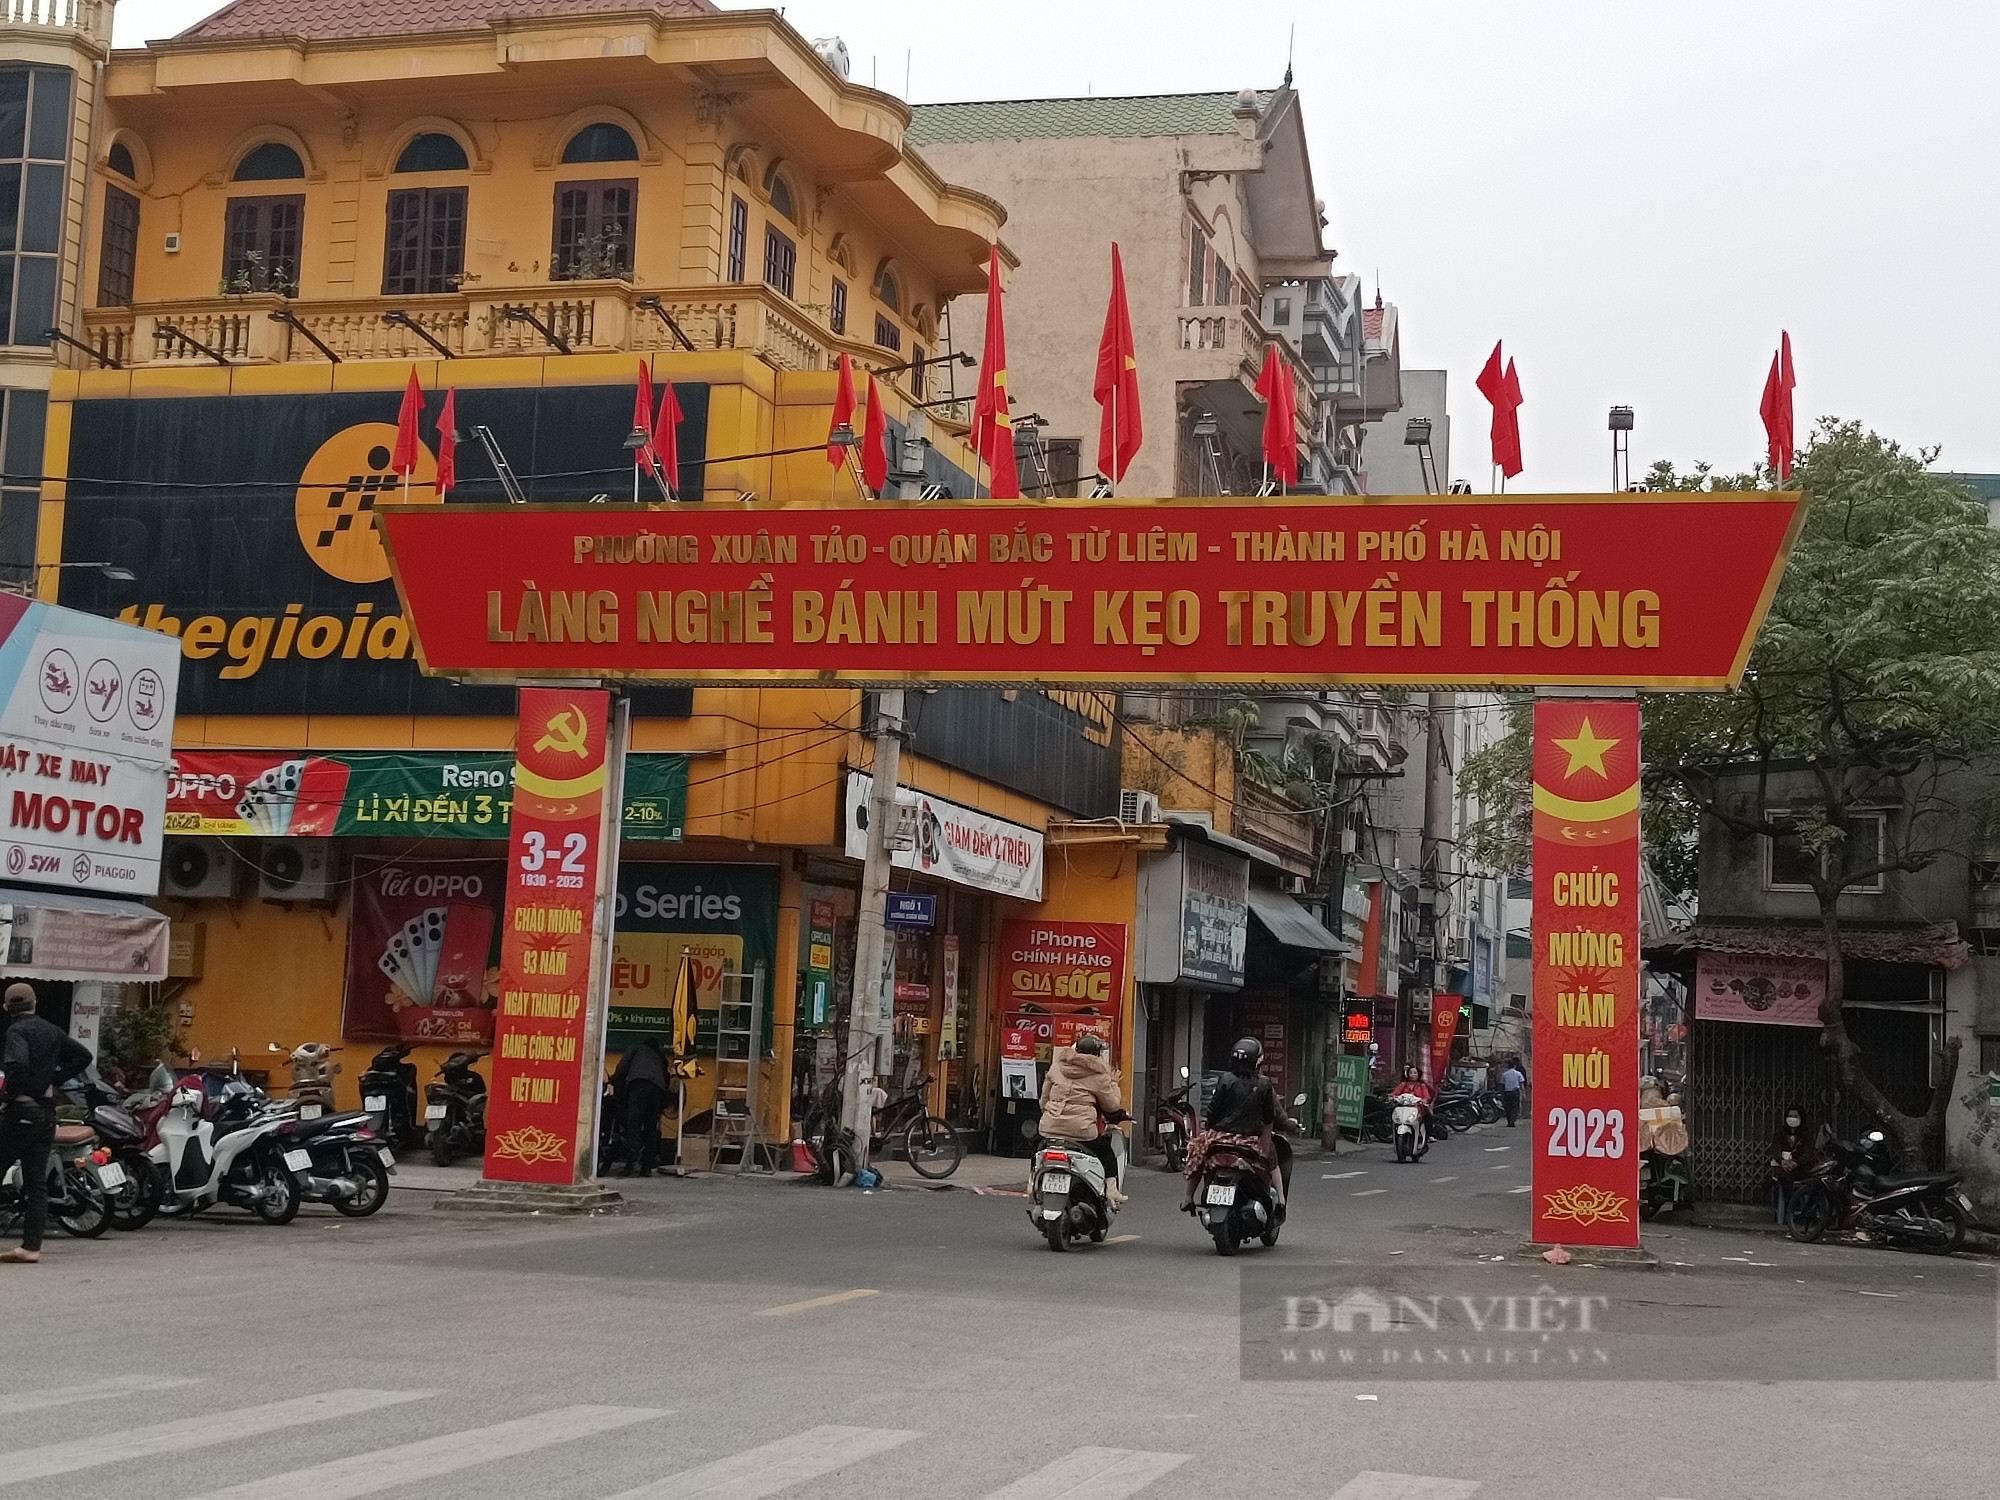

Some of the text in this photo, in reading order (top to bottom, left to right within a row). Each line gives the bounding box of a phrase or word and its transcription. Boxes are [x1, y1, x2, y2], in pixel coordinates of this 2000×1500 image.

[574, 529, 698, 564] PHƯỜNG
[711, 528, 796, 563] XUÂN
[990, 521, 1052, 563] BẮC
[1067, 526, 1111, 562] TỪ
[1119, 526, 1197, 562] LIÊM
[1232, 525, 1344, 562] THÀNH
[1358, 520, 1428, 562] PHỐ
[1440, 524, 1490, 561] HÀ
[1501, 524, 1561, 567] NỘI
[487, 570, 1660, 656] LÀNG NGHỀ BÁNH MỨT KẸO TRUYỀN THỐNG
[36, 752, 63, 779] XE
[442, 764, 504, 788] Reno
[167, 774, 236, 800] OPPO
[10, 790, 145, 844] MOTOR
[356, 792, 379, 822] LÌ
[383, 792, 411, 823] XÌ
[412, 793, 469, 824] ĐẾN
[474, 794, 493, 824] 3
[520, 831, 588, 873] 3-2
[944, 816, 1032, 871] GIẢM ĐẾN 2 TRIỆU
[28, 853, 61, 873] SYM
[94, 865, 136, 880] PIAGGIO
[380, 868, 483, 898] Tết OPPO
[519, 873, 547, 887] 1930
[556, 875, 584, 889] 2023
[1553, 865, 1619, 908] CHÚC
[514, 902, 547, 934] CHÀO
[547, 902, 583, 935] MỪNG
[634, 884, 741, 920] Series
[702, 944, 726, 959] góp
[1030, 929, 1097, 949] iPhone
[1549, 925, 1623, 968] MỪNG
[522, 947, 567, 976] 93 NĂM
[1011, 949, 1062, 966] CHÍNH
[1011, 968, 1112, 1001] GIÁ SỐC
[503, 986, 581, 1025] NGÀY THÀNH LẬP
[1557, 985, 1615, 1028] NĂM
[501, 1026, 576, 1066] ĐẢNG CỘNG SẢN
[1562, 1046, 1610, 1089] MỚI
[510, 1072, 530, 1108] VIỆT
[531, 1077, 554, 1104] NAM
[1548, 1107, 1624, 1159] 2023
